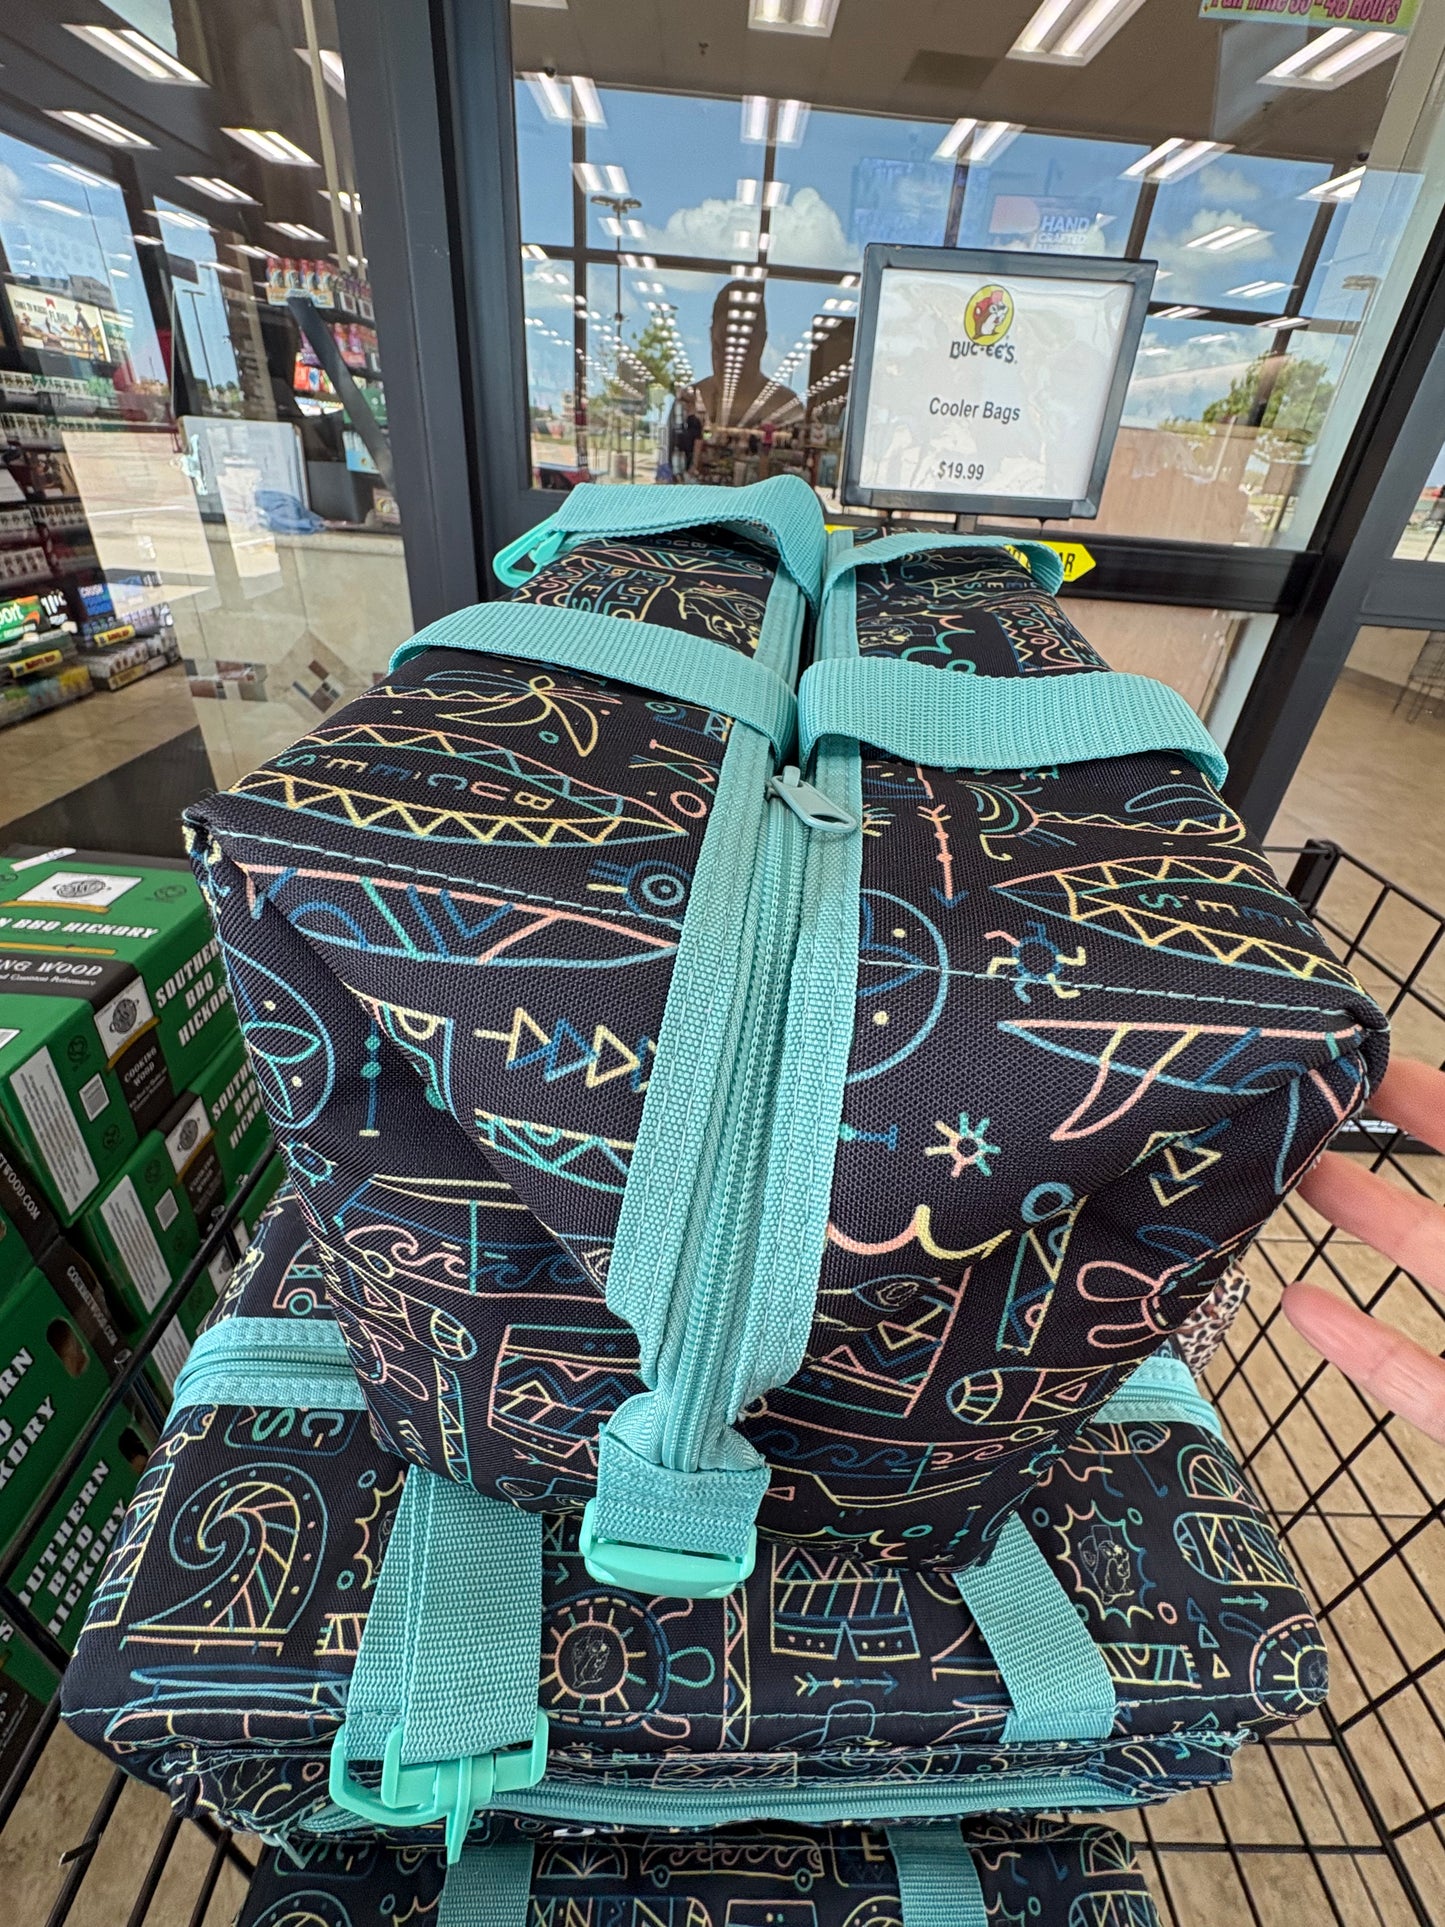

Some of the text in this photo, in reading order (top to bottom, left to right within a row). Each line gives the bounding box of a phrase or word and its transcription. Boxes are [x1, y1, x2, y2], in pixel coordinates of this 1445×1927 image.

[928, 396, 1021, 425] Cooler Bags
[936, 459, 985, 481] $19.99
[61, 921, 159, 939] HICKORY
[37, 961, 104, 977] WOOD
[154, 937, 221, 1009] SOUTHER
[177, 984, 229, 1048] HICKOR
